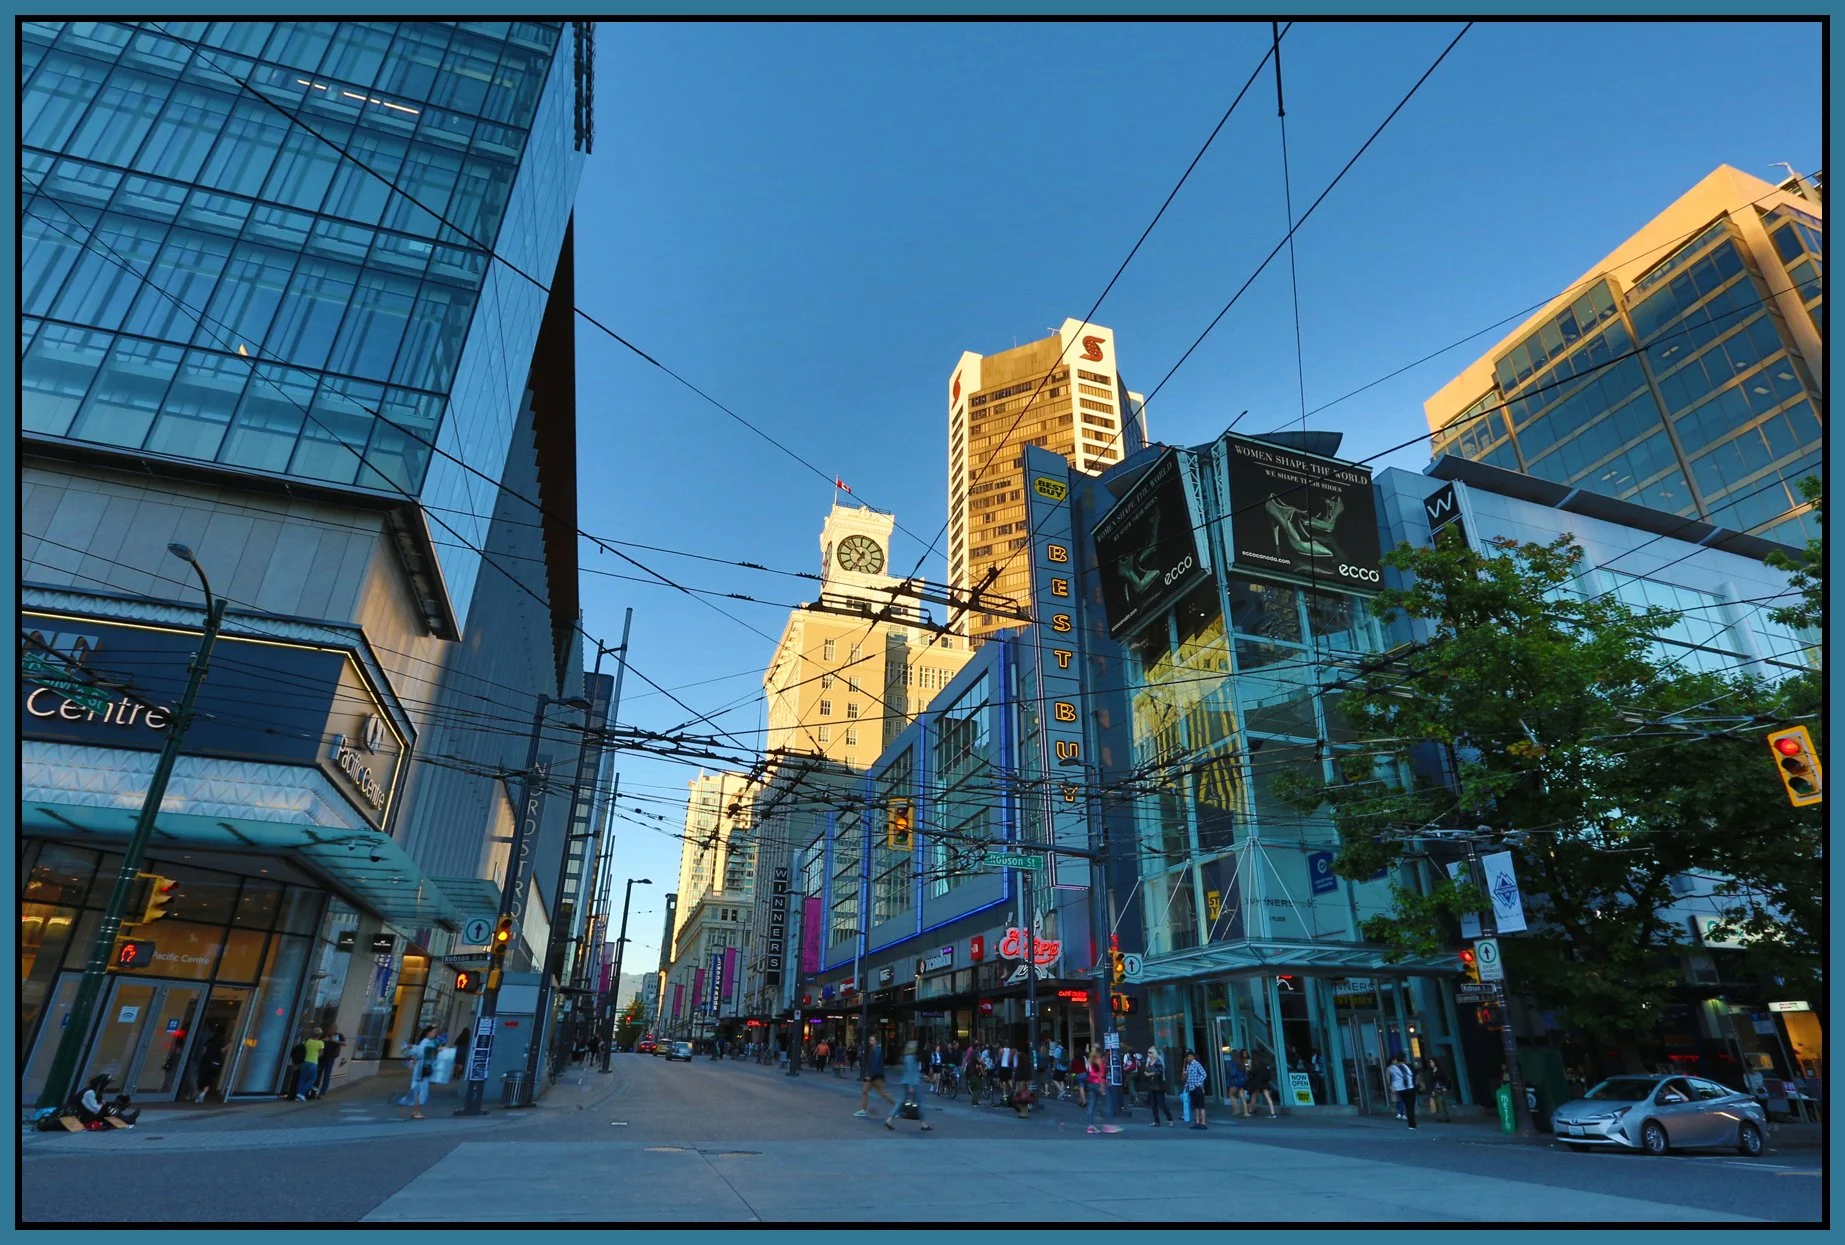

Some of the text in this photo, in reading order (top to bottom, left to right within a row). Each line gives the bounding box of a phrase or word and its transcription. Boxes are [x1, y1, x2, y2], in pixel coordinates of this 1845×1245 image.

[1235, 445, 1368, 485] WOMEN SHAPE THE WORLD
[1038, 480, 1065, 492] BEST
[1039, 487, 1062, 497] BUY
[1265, 469, 1276, 477] WE
[1277, 473, 1299, 483] SHAPE
[1321, 483, 1342, 492] SHOES
[1096, 521, 1117, 543] WOMEN
[1117, 500, 1135, 521] SHAPE
[1149, 461, 1173, 488] WORLD
[1427, 491, 1452, 518] W
[1241, 550, 1291, 565] eccocanada.com
[1164, 555, 1193, 586] ecco
[1338, 563, 1379, 582] ecco
[1048, 544, 1073, 669] BEST
[336, 734, 385, 810] Pacific Centre
[990, 855, 1036, 867] Robson St
[770, 868, 787, 967] WINNERS
[181, 954, 209, 965] Centre
